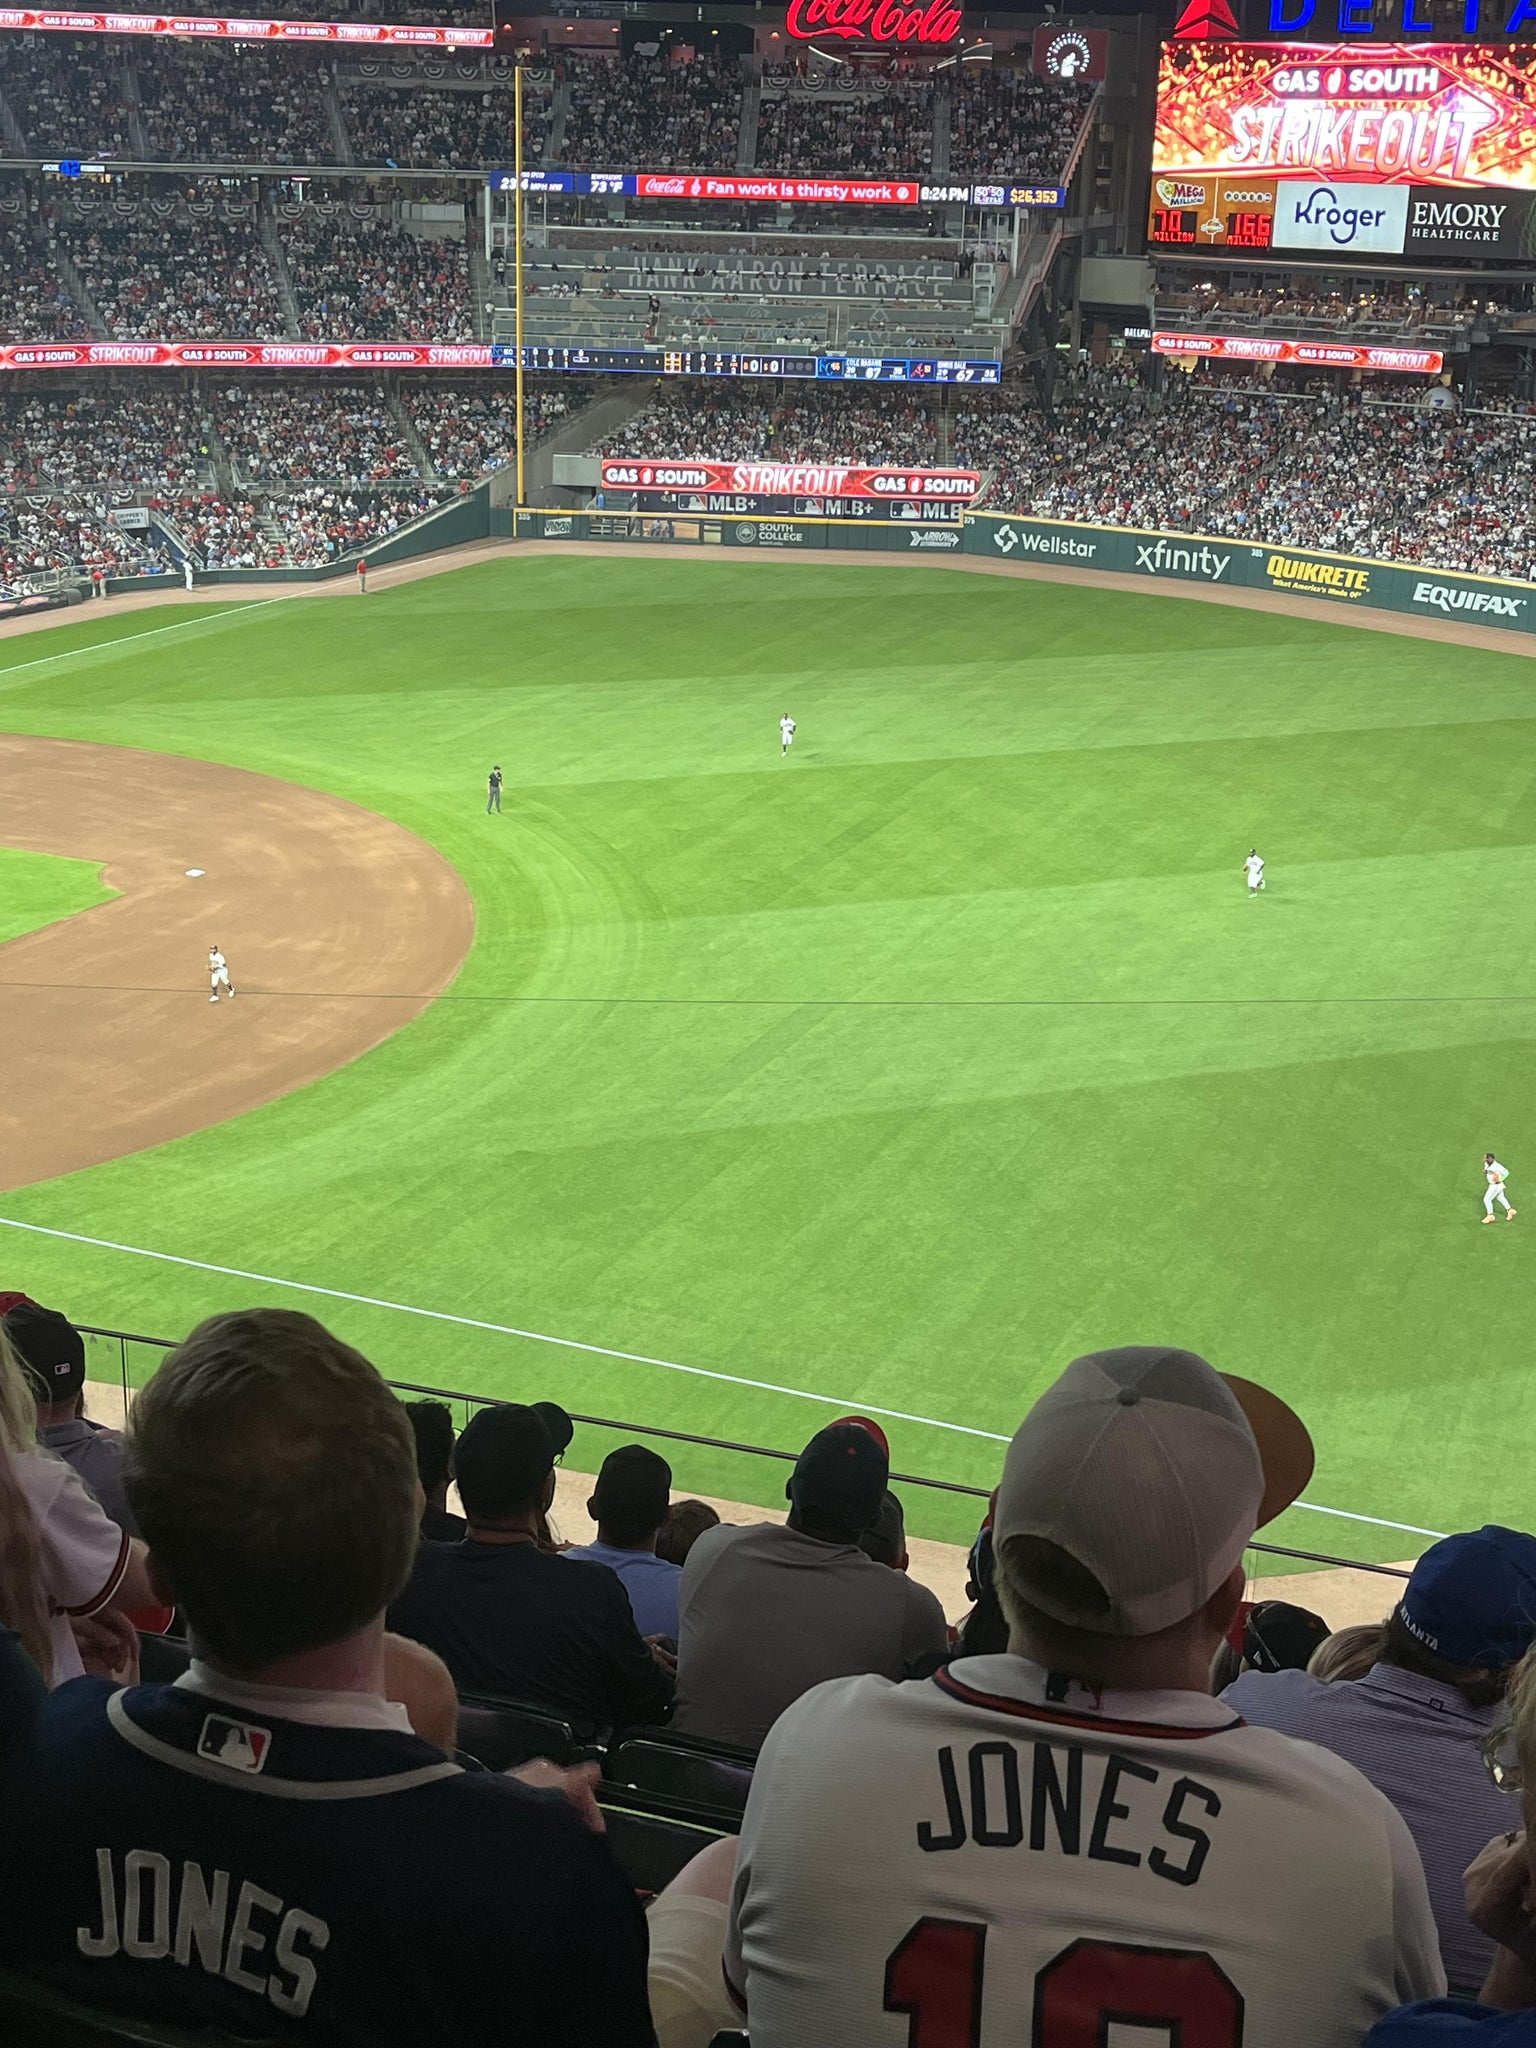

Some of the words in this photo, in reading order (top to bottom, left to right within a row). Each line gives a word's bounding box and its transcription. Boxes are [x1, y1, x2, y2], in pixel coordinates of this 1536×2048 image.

[44, 17, 60, 25] GAS
[69, 18, 95, 26] SOUTH
[105, 17, 157, 31] STRIKEOUT
[174, 22, 190, 30] GAS
[196, 23, 218, 32] SOUTH
[226, 23, 271, 36] STRIKEOUT
[306, 28, 328, 36] SOUTH
[337, 27, 380, 39] STRIKEOUT
[415, 32, 437, 41] SOUTH
[445, 30, 487, 43] STRIKEOUT
[1272, 69, 1319, 93] GAS
[1349, 68, 1439, 92] SOUTH
[1226, 105, 1491, 179] STRIKEOUT
[590, 181, 606, 192] 73
[610, 181, 623, 193] °F
[707, 181, 734, 194] Fan
[741, 182, 777, 196] work
[781, 182, 794, 196] is
[796, 183, 848, 200] thirsty
[852, 185, 892, 199] work
[921, 186, 948, 201] 8:24
[949, 187, 969, 201] PM
[1174, 183, 1204, 198] MEGA
[1010, 187, 1058, 205] $26,353
[1295, 187, 1387, 244] Kroger
[1412, 202, 1508, 228] EMORY
[1235, 213, 1272, 236] 166
[1226, 235, 1268, 247] MILLION
[1412, 228, 1499, 242] HEALTHCARE
[628, 255, 700, 291] HANK
[711, 260, 805, 293] AARON
[819, 262, 945, 298] TERRACE
[1159, 338, 1175, 347] GAS
[1184, 340, 1212, 350] SOUTH
[1224, 340, 1283, 357] STRIKEOUT
[15, 352, 34, 362] GAS
[45, 351, 76, 361] SOUTH
[89, 346, 157, 363] STRIKEOUT
[182, 350, 203, 360] GAS
[214, 350, 247, 361] SOUTH
[261, 347, 328, 363] STRIKEOUT
[352, 351, 373, 361] GAS
[382, 351, 415, 361] SOUTH
[428, 347, 492, 364] STRIKEOUT
[1299, 348, 1317, 358] GAS
[1326, 350, 1355, 361] SOUTH
[1368, 351, 1430, 369] STRIKEOUT
[750, 360, 758, 372] 0
[770, 361, 779, 373] 0
[956, 369, 975, 381] 67
[606, 470, 637, 484] GAS
[656, 470, 706, 485] SOUTH
[732, 466, 848, 496] STRIKEOUT
[874, 476, 906, 491] GAS
[923, 478, 975, 493] SOUTH
[709, 496, 757, 513] MLB+
[825, 499, 874, 516] MLB+
[923, 502, 961, 519] MLB
[759, 523, 794, 533] SOUTH
[759, 532, 803, 542] COLLEGE
[921, 531, 952, 542] ARROW
[1021, 533, 1097, 558] Wellstar
[1135, 539, 1231, 580] xfinity
[1266, 555, 1370, 590] QUIKRETE
[1272, 578, 1292, 589] What
[1292, 581, 1327, 594] America's
[1327, 587, 1348, 598] Made
[1413, 582, 1522, 617] EQUIFAX
[917, 1741, 1222, 1887] JONES
[77, 1848, 330, 2017] JONES
